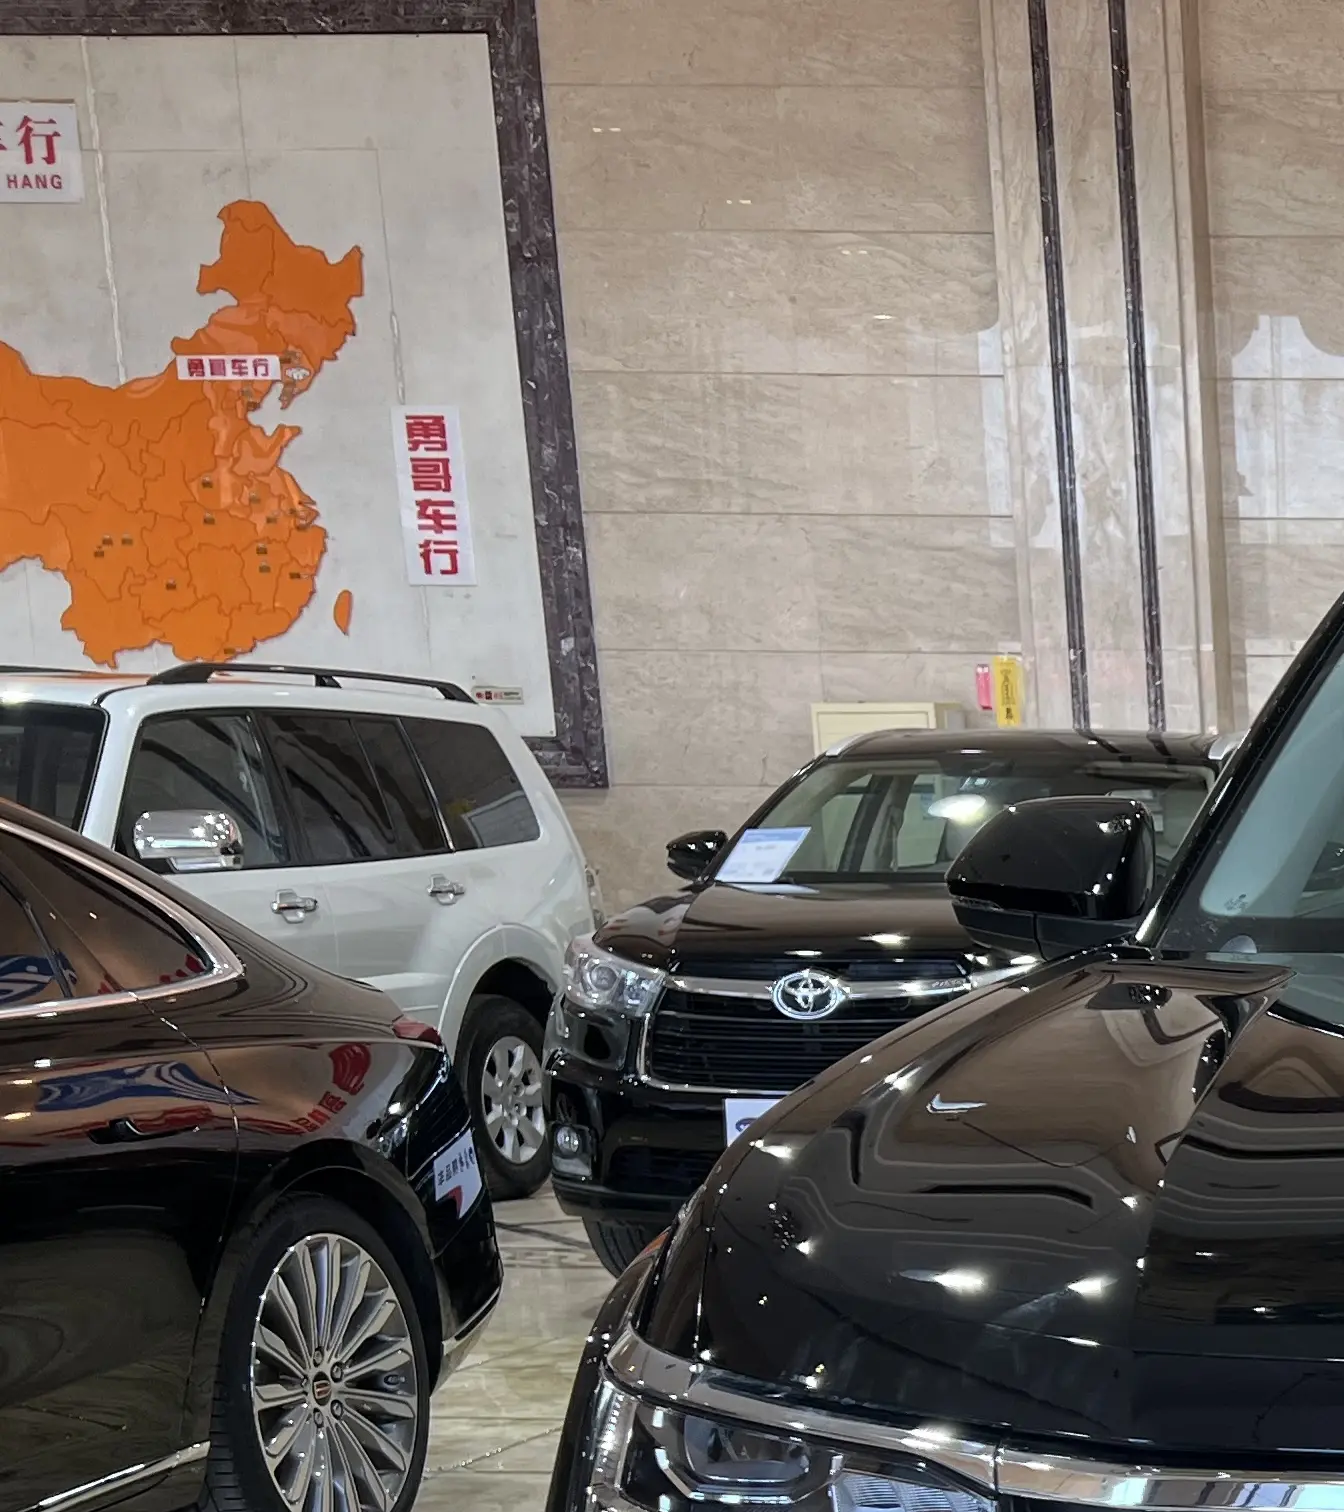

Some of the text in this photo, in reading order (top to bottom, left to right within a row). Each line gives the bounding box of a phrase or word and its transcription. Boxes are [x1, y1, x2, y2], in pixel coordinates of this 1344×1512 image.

[0, 114, 62, 165] 行
[6, 173, 63, 190] HANG
[405, 414, 459, 575] 勇哥车行
